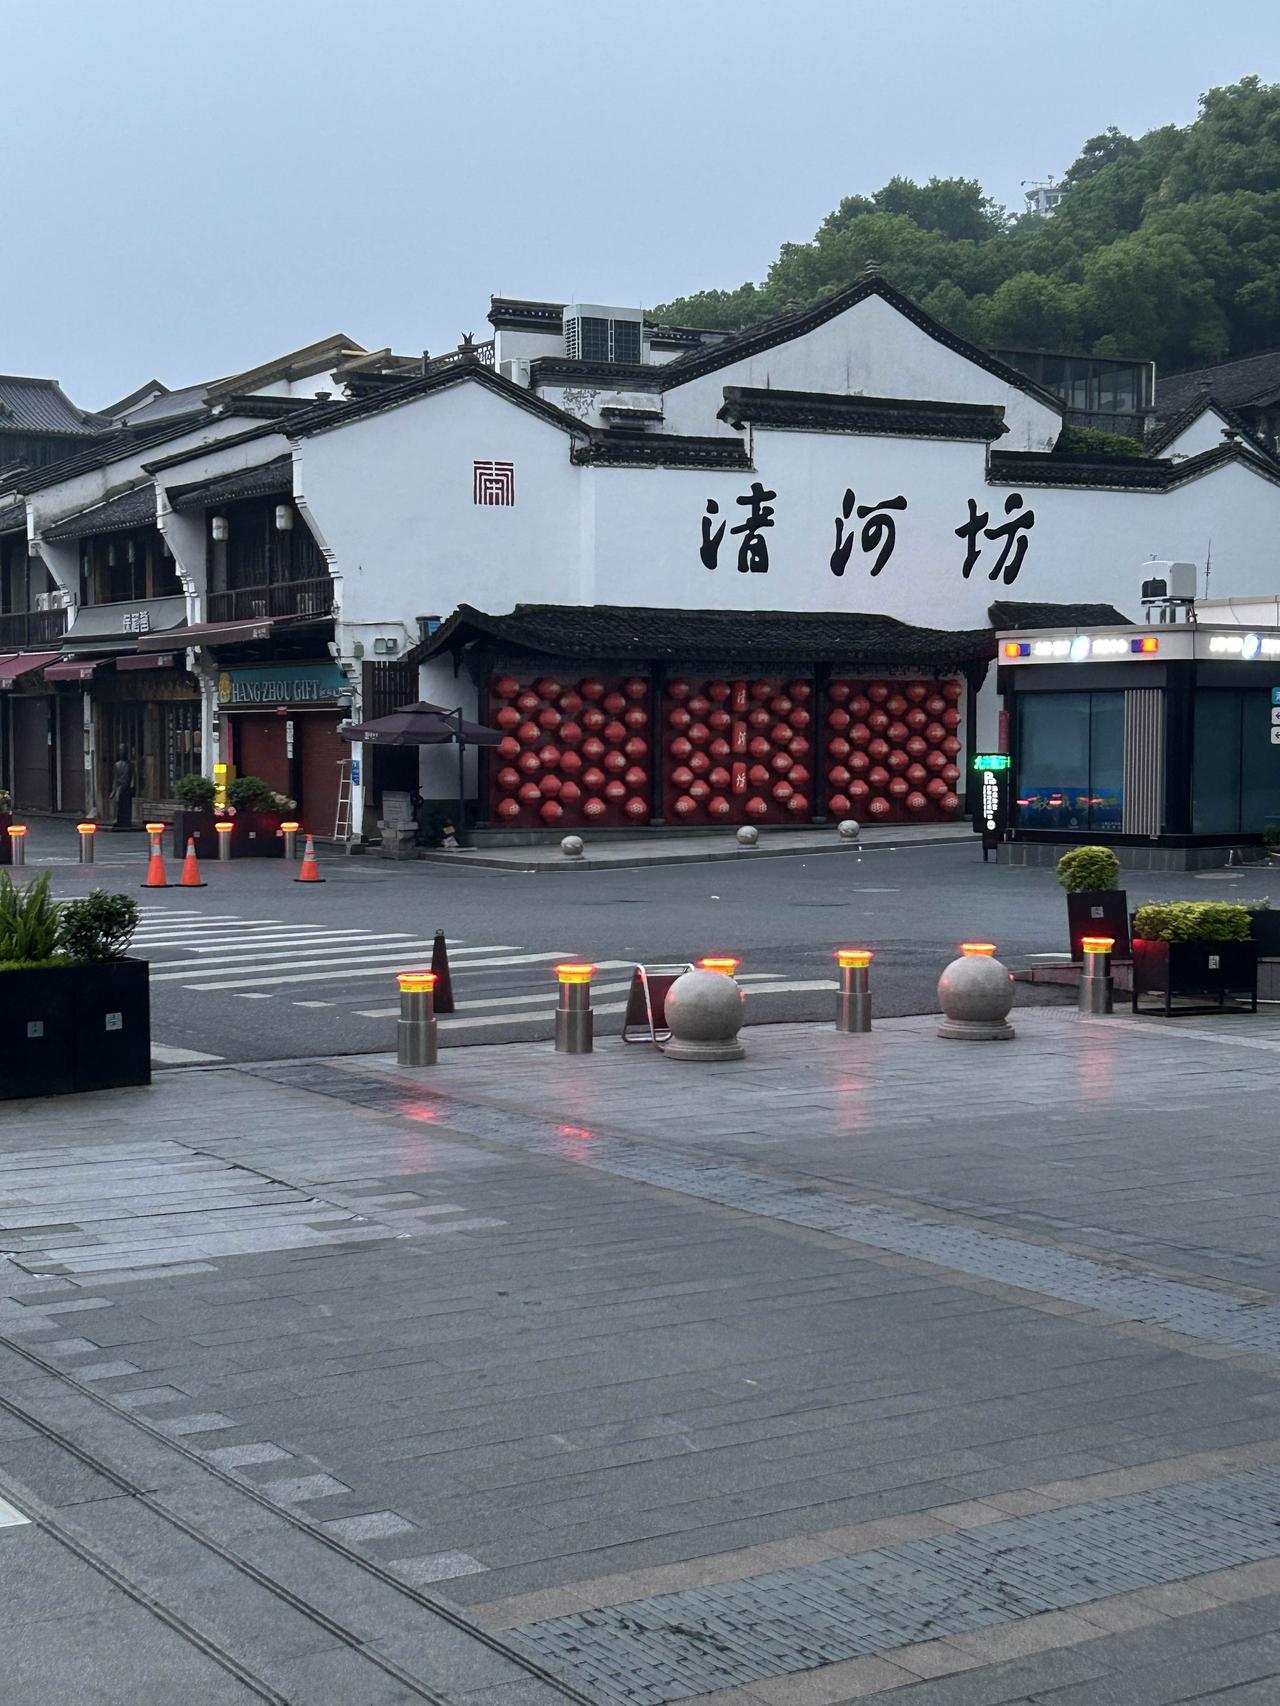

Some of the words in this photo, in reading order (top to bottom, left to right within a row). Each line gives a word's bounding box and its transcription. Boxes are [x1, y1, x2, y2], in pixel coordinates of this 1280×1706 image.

[699, 482, 1035, 585] 清河坊
[293, 679, 320, 701] GIFT
